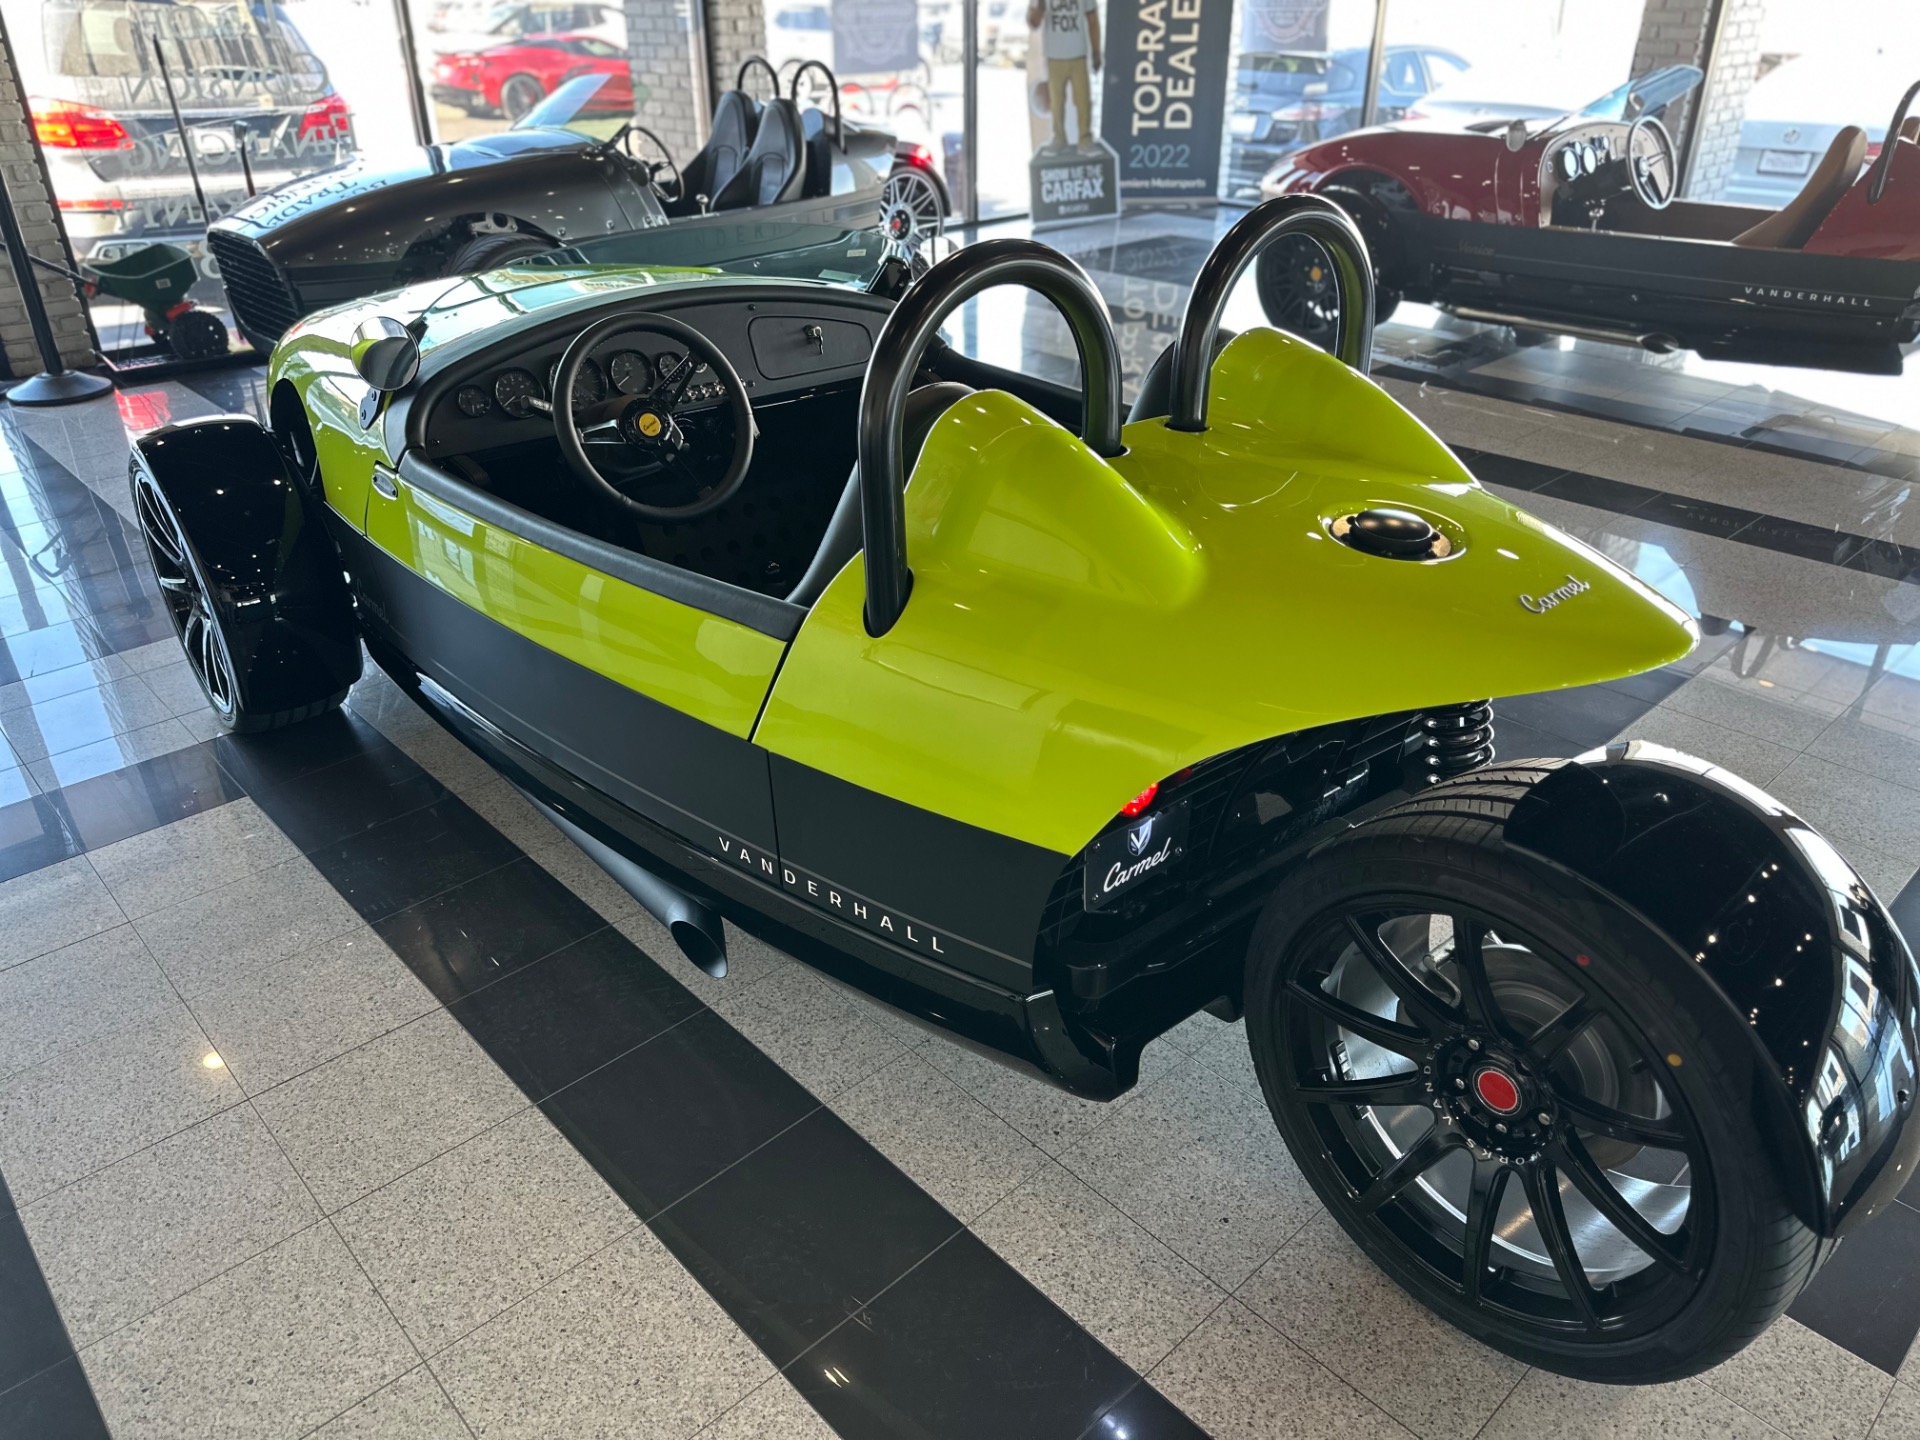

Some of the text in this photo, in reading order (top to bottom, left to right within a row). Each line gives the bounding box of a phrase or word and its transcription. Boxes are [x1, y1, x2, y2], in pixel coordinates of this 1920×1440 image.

[1052, 15, 1080, 32] FOX
[1131, 0, 1168, 136] TOP-RA
[1129, 144, 1190, 168] 2022
[1042, 178, 1104, 203] CARFAX
[1744, 286, 1871, 307] VANDERHALL
[1520, 574, 1590, 613] Carmel
[1103, 837, 1171, 893] Carmel
[718, 836, 945, 954] VANDERHALL
[1424, 1033, 1480, 1125] VANDERHA
[1466, 1138, 1541, 1165] WORKS
